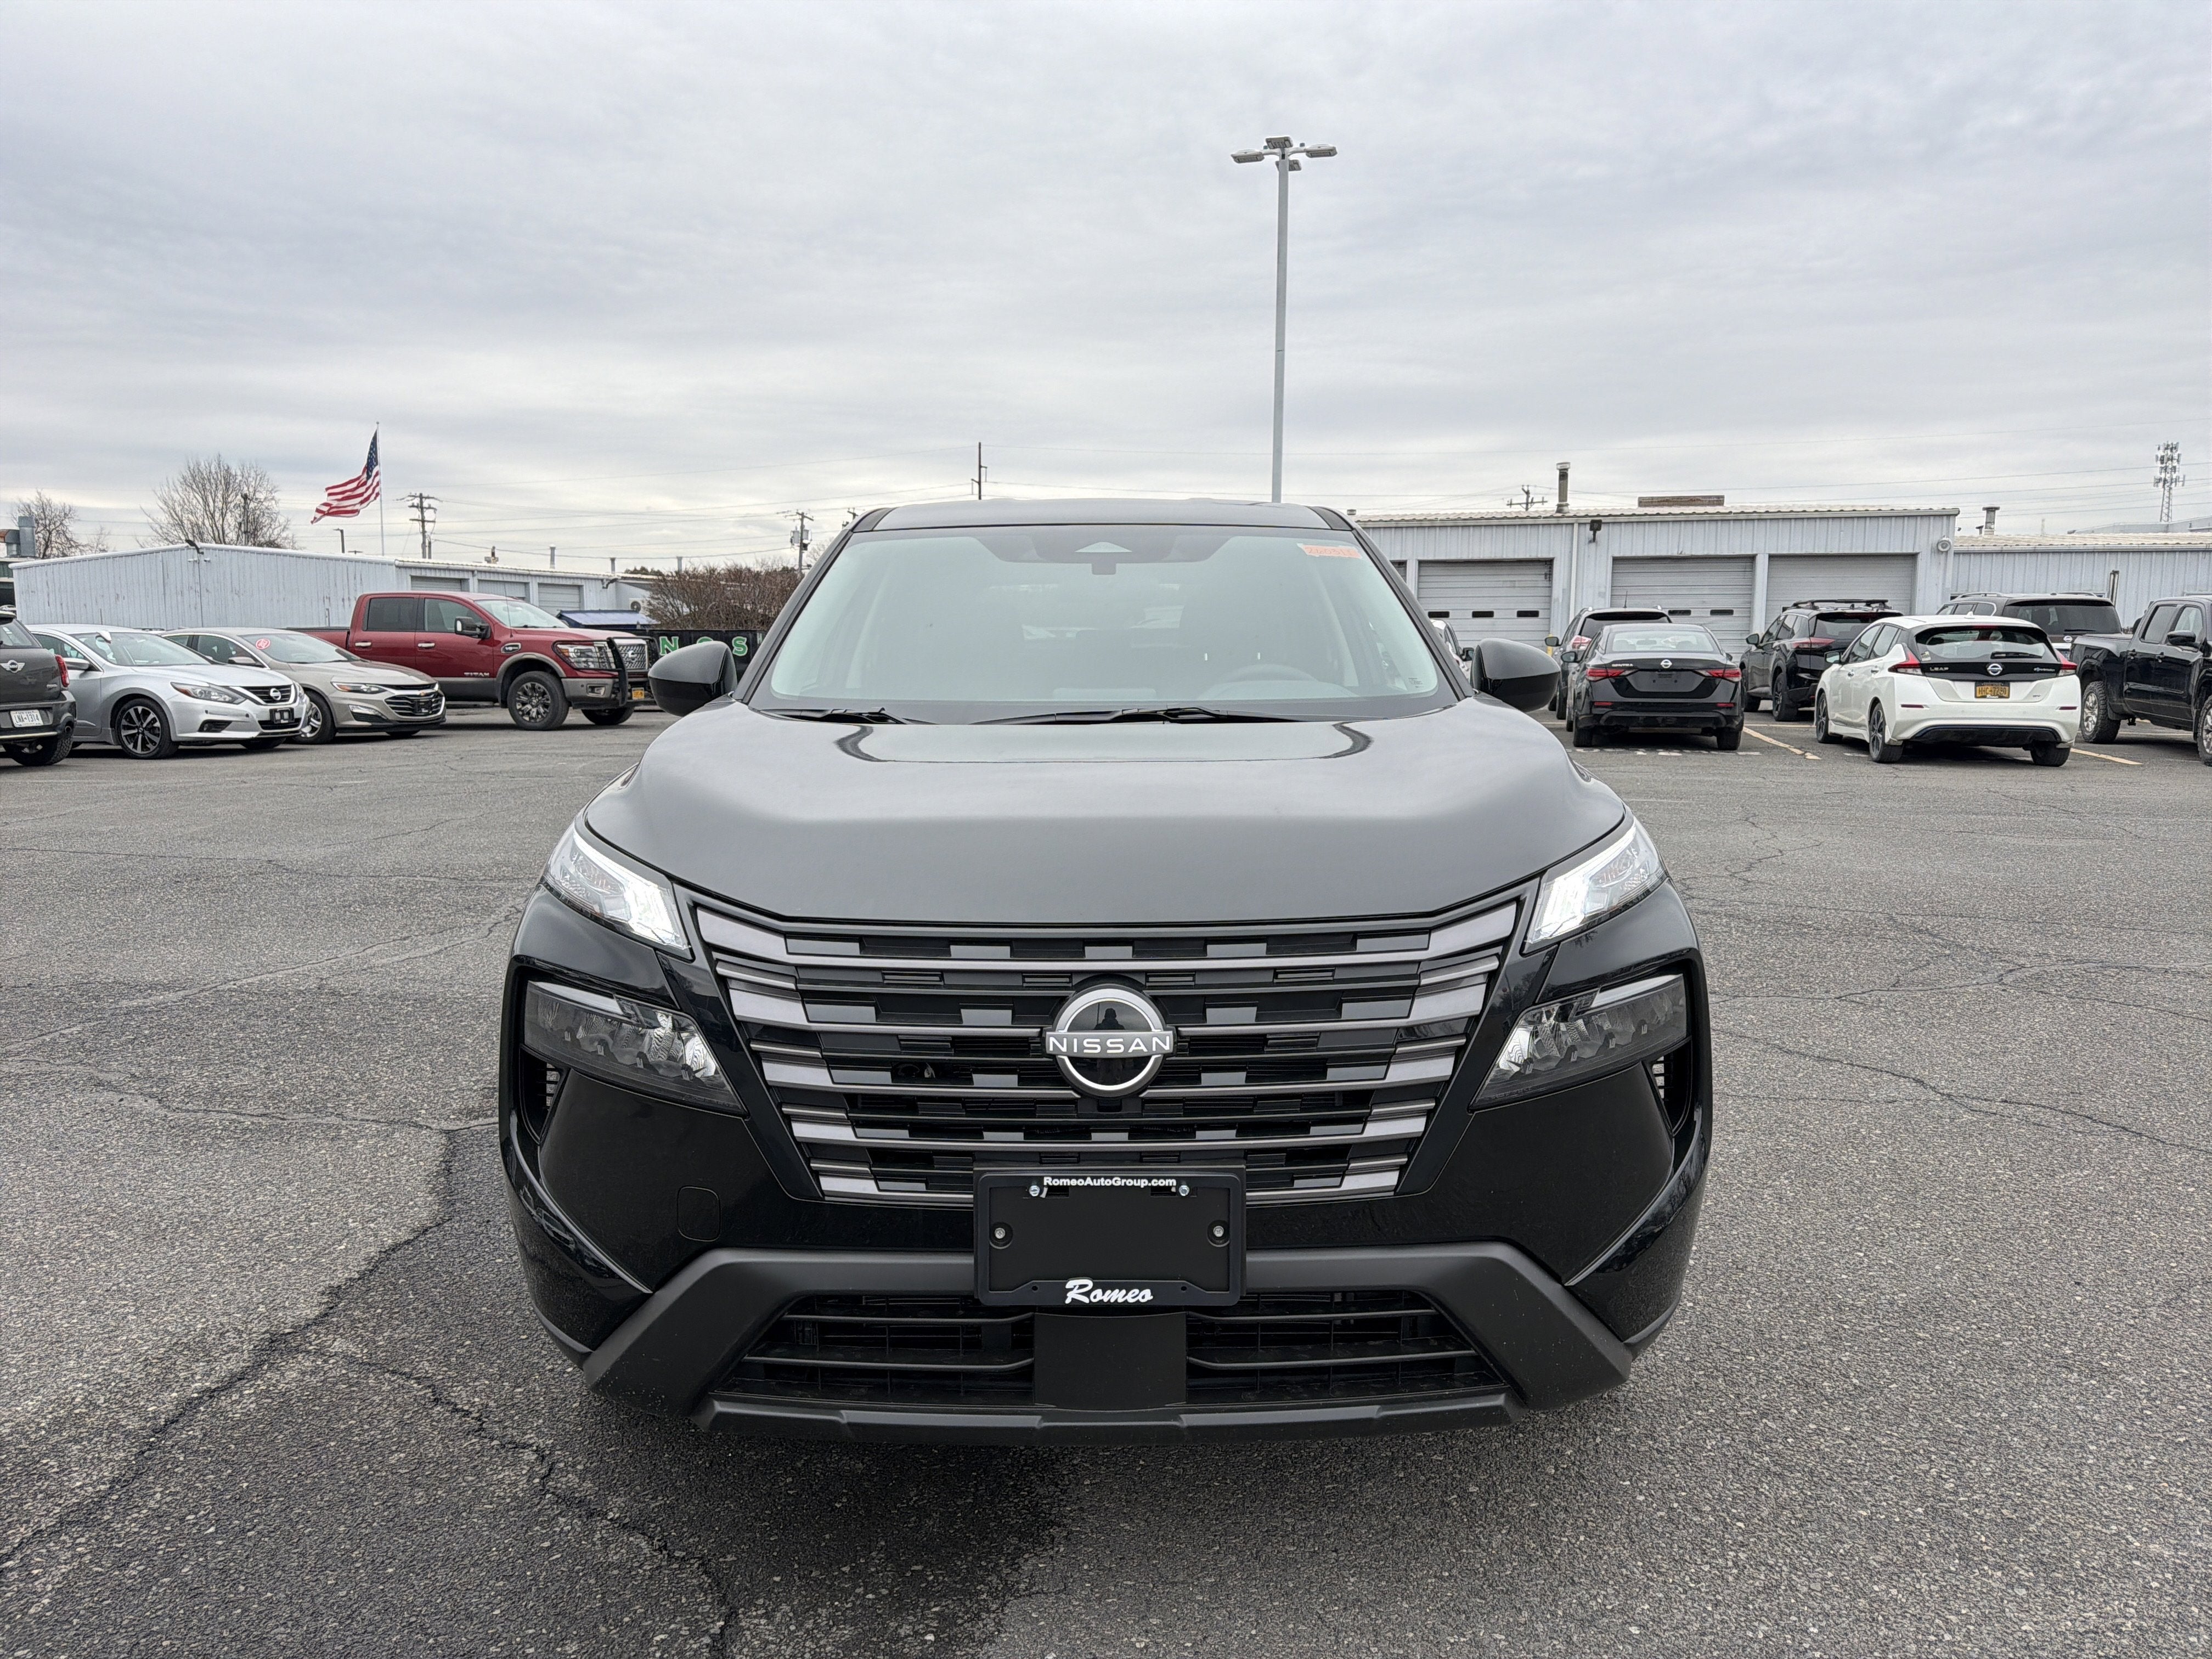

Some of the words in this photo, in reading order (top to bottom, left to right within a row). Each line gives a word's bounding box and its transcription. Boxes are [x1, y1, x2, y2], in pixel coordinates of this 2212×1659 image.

[1049, 1035, 1170, 1053] NISSAN
[1043, 1177, 1176, 1188] RomeoAutoGroup.com
[1065, 1279, 1153, 1304] Romeo
